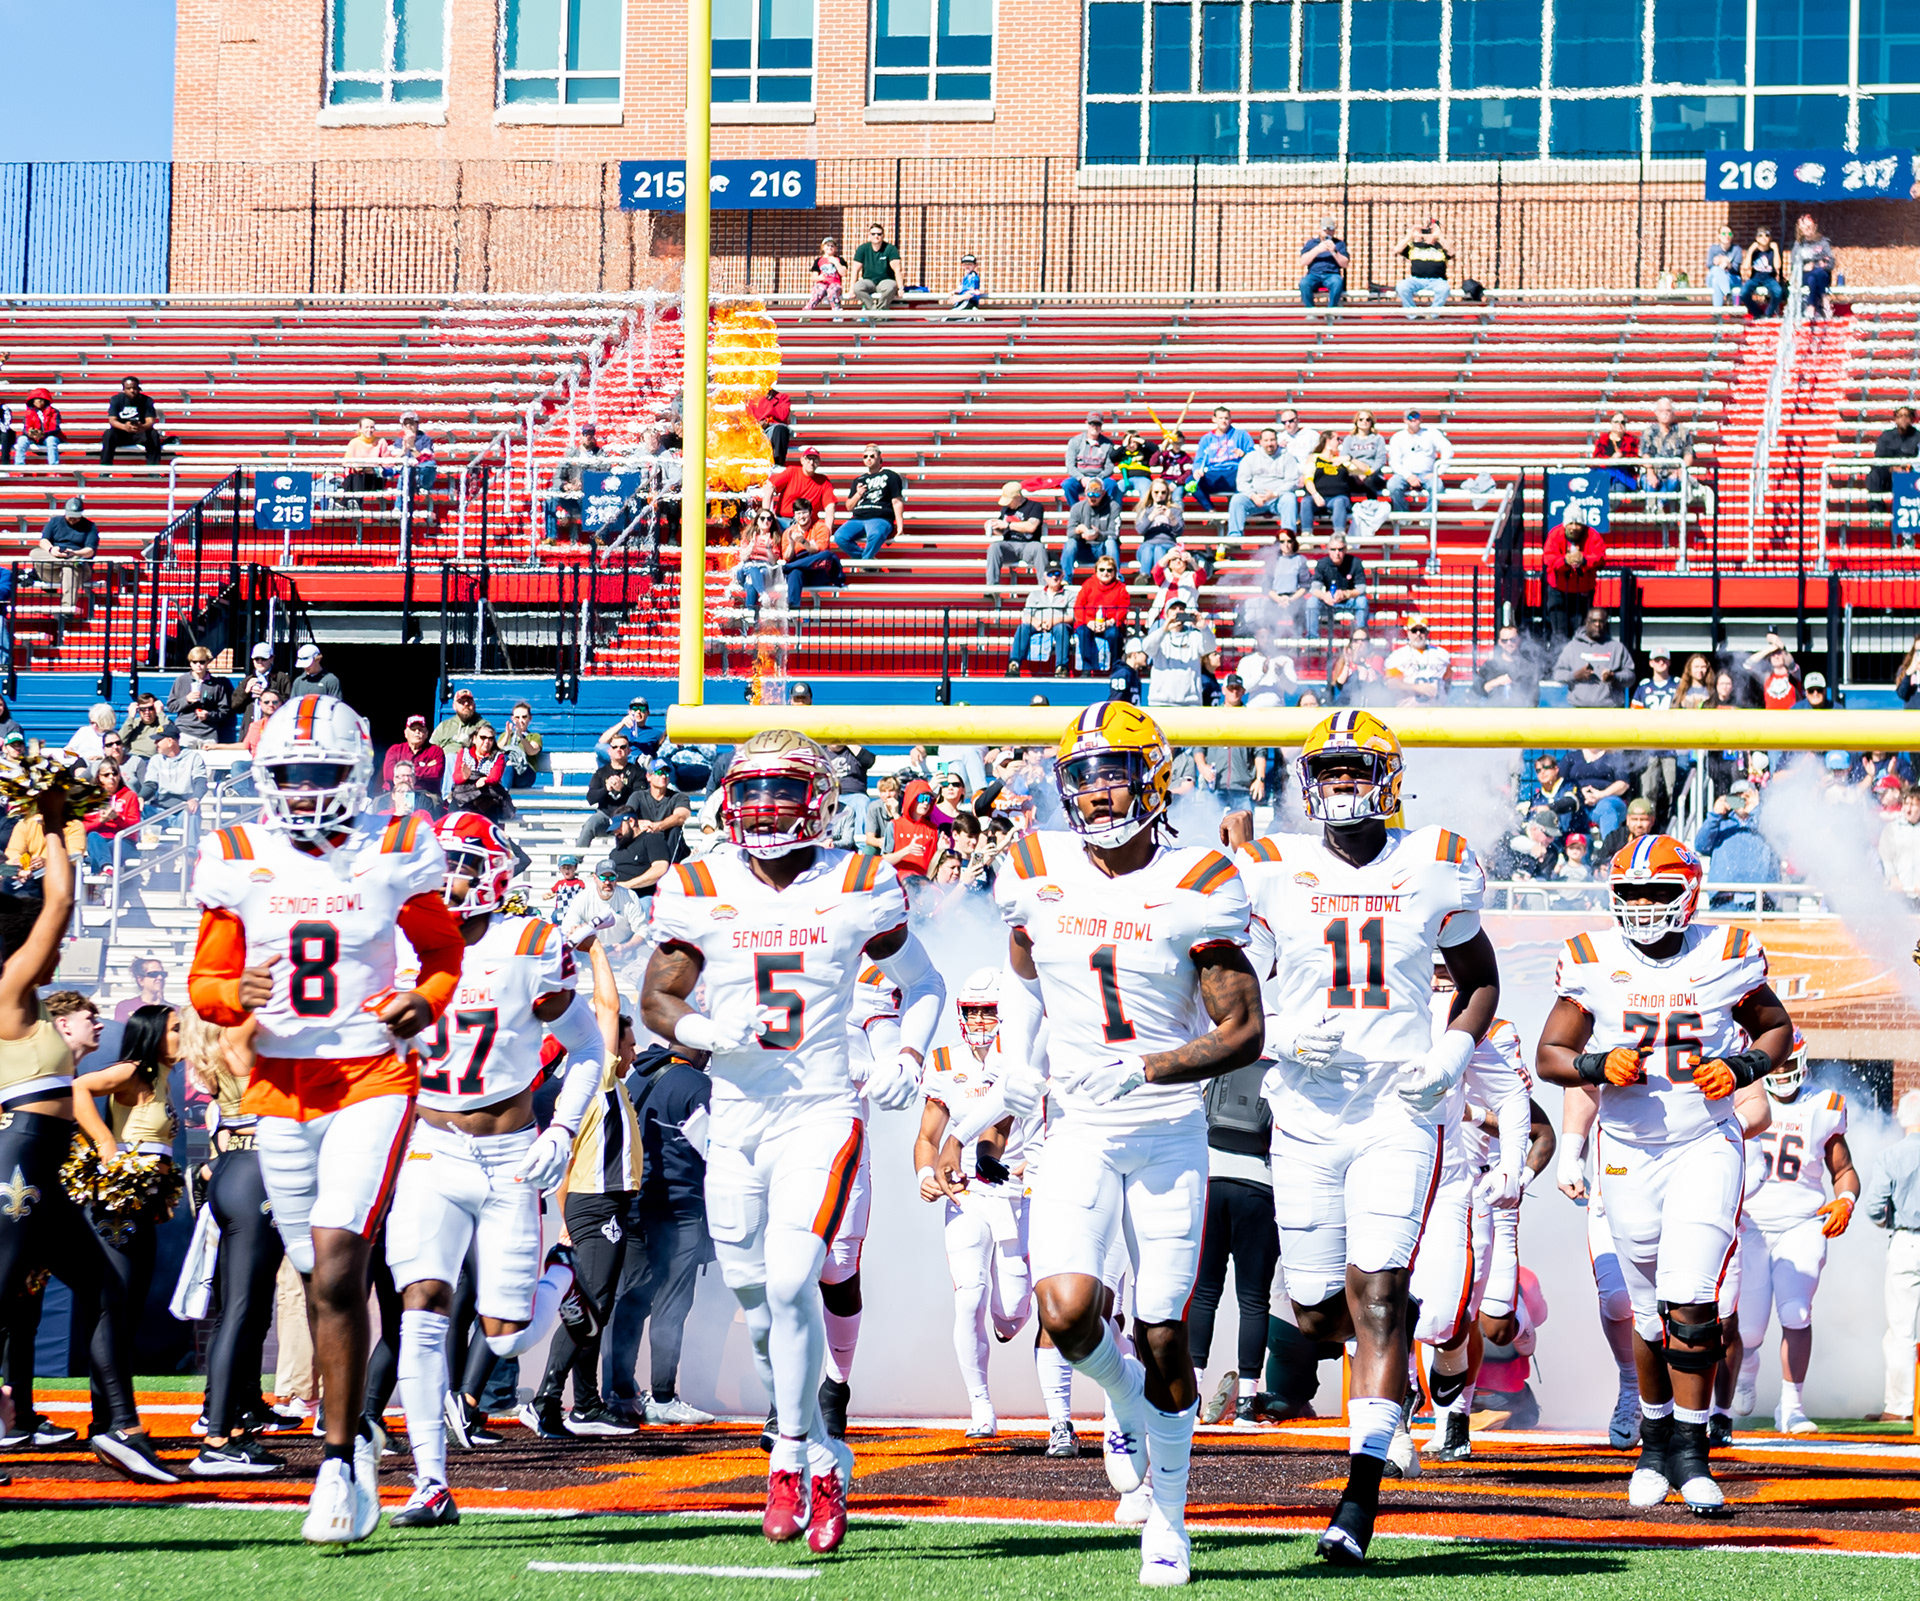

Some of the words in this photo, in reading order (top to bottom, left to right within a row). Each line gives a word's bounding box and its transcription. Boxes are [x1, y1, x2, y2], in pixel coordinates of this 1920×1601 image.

[633, 170, 685, 198] 215
[749, 170, 802, 198] 216
[1718, 160, 1778, 190] 216
[1842, 156, 1898, 192] 217
[275, 494, 307, 504] Section
[272, 505, 304, 523] 215
[1582, 506, 1601, 527] 16
[1897, 508, 1920, 528] 21
[1079, 741, 1099, 750] LSU
[269, 896, 318, 914] SENIOR
[326, 893, 365, 914] BOWL
[1310, 895, 1359, 913] SENIOR
[1365, 895, 1402, 912] BOWL
[732, 930, 783, 949] SENIOR
[789, 926, 828, 946] BOWL
[1057, 915, 1107, 938] SENIOR
[1113, 921, 1153, 941] BOWL
[289, 919, 340, 1018] 8
[1323, 916, 1390, 1010] 11
[460, 987, 495, 1005] BOWL
[754, 951, 806, 1051] 5
[1089, 943, 1137, 1044] 1
[1627, 993, 1665, 1008] SENIOR
[1669, 992, 1699, 1007] BOWL
[420, 1007, 499, 1096] 27
[1623, 1010, 1704, 1086] 76
[965, 1086, 989, 1099] SENIO
[1785, 1122, 1803, 1132] BOWL
[1759, 1131, 1804, 1182] 56
